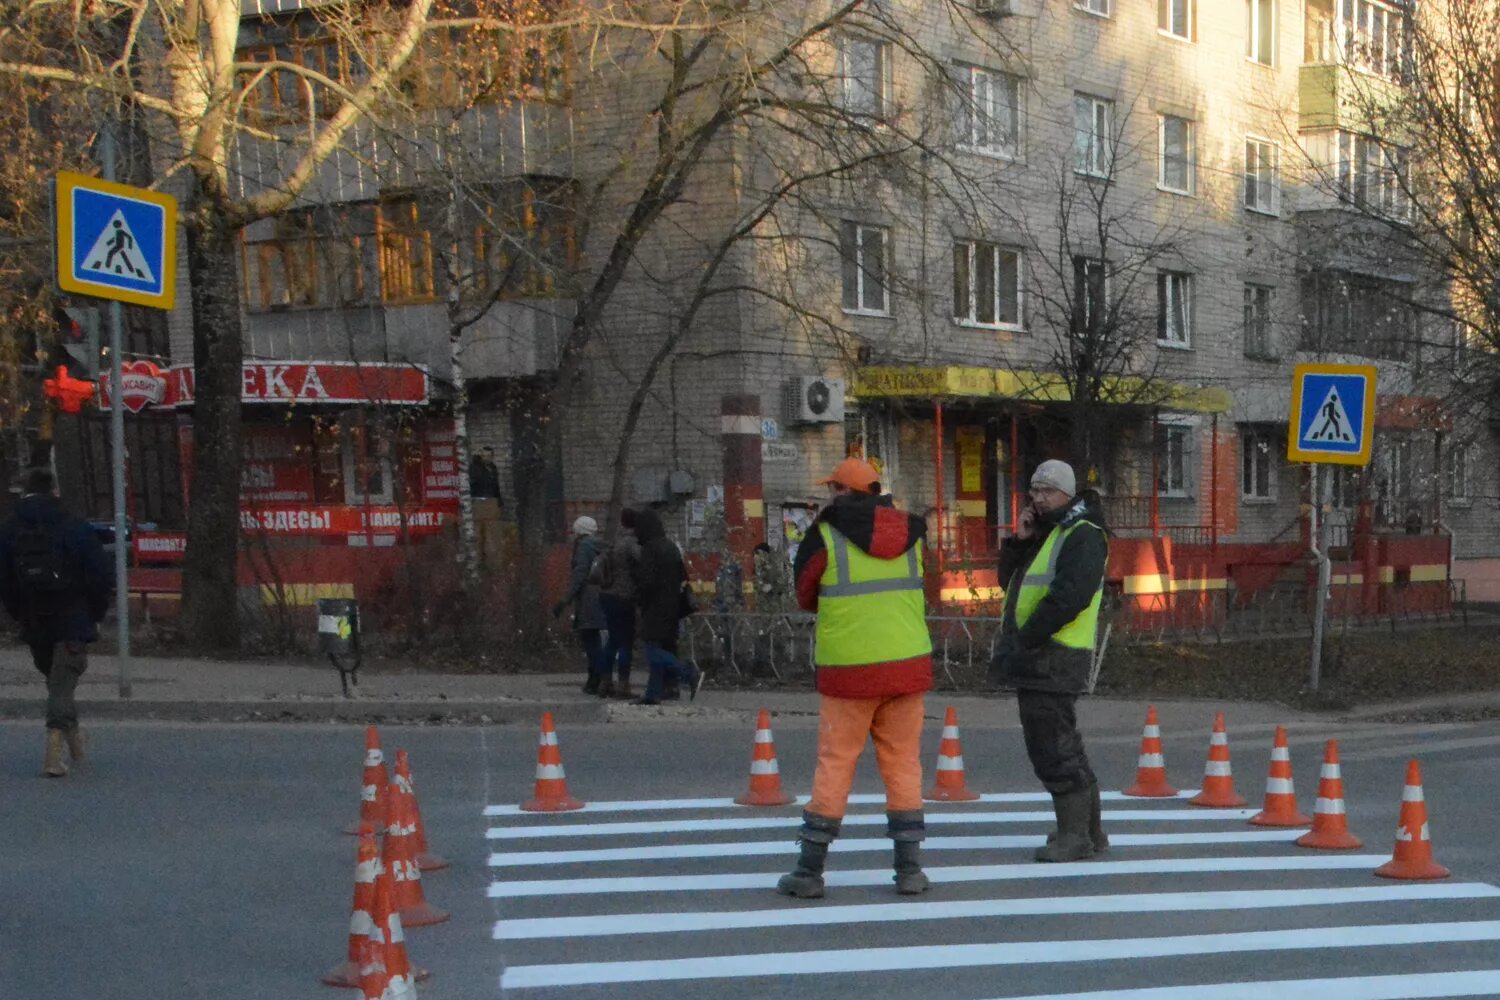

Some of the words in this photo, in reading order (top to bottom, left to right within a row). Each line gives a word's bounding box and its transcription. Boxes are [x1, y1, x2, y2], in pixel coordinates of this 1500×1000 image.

[179, 366, 329, 400] АЕКА
[763, 420, 777, 438] 36
[264, 511, 330, 531] ЗДЕСЬ!
